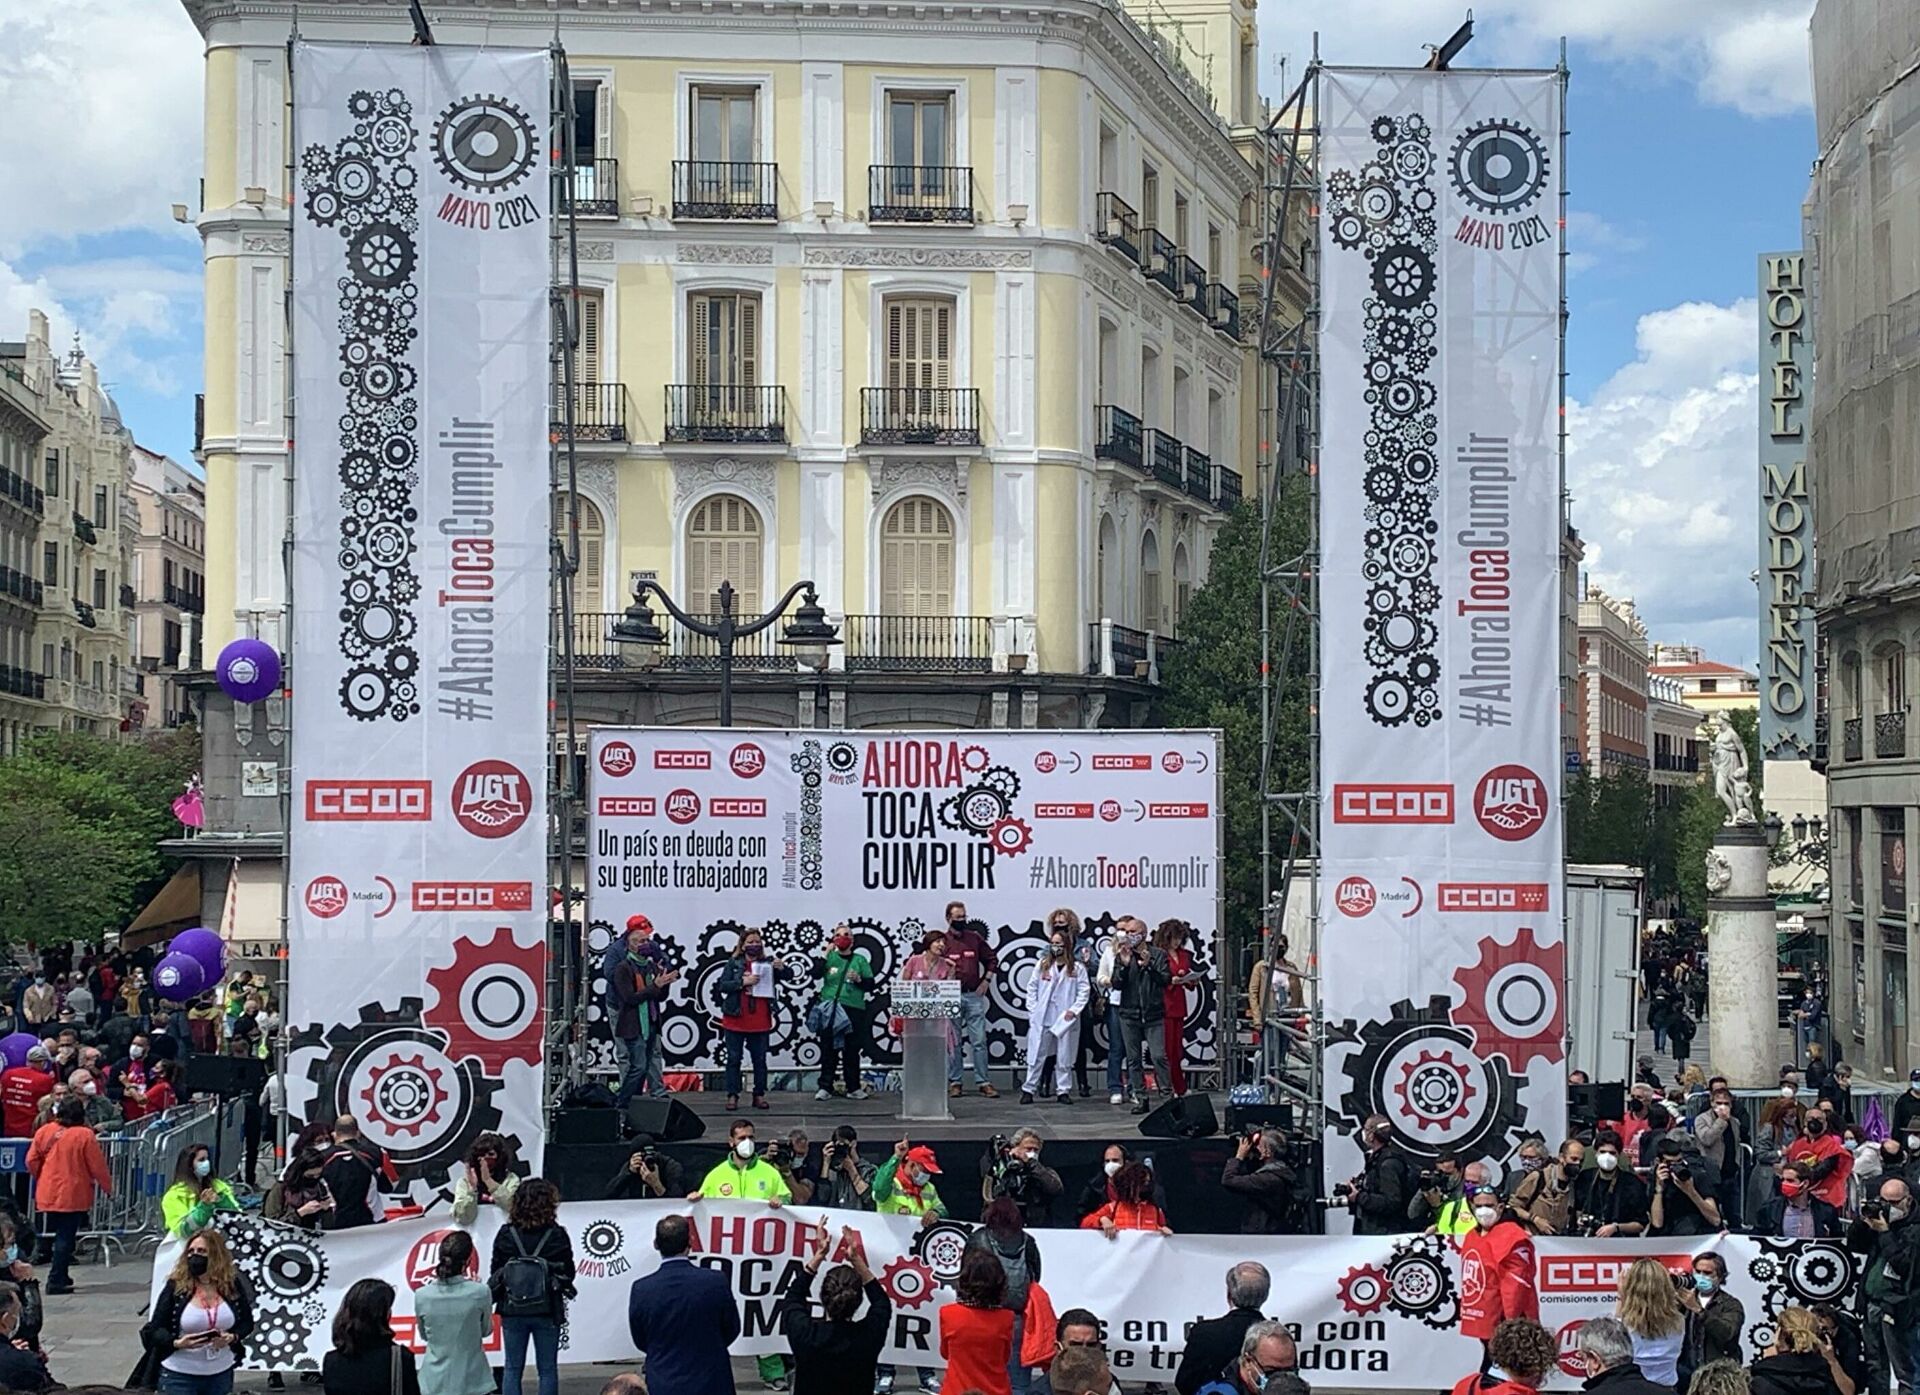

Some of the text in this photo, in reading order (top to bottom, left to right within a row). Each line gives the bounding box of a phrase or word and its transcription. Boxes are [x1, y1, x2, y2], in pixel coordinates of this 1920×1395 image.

[437, 193, 541, 230] MAYO 2021
[1454, 214, 1551, 251] MAYO 2021
[1762, 257, 1808, 714] HOTEL MODERNO
[438, 417, 503, 721] #AhoraTocaCumplir
[1457, 432, 1517, 726] #AhoraTocaCumplir
[606, 747, 630, 762] UGT
[657, 754, 708, 767] CCOO
[736, 748, 760, 763] UGT
[862, 741, 964, 788] AHORA
[1095, 757, 1133, 767] CCOO
[462, 774, 521, 802] UGT
[1484, 779, 1538, 807] UGT
[314, 788, 424, 813] CCOO
[602, 801, 653, 813] CCOO
[672, 795, 696, 809] UGT
[713, 802, 764, 815] CCOO
[1037, 806, 1076, 815] CCOO
[1152, 806, 1190, 815] CCOO
[1342, 792, 1448, 816] CCOO
[862, 792, 937, 839] TOCA
[598, 829, 767, 860] Un país en deuda con
[598, 861, 767, 892] su gente trabajadora
[862, 842, 996, 890] CUMPLIR
[1030, 856, 1209, 893] #AhoraTocaCumplir
[309, 883, 383, 901] UGT Madrid
[418, 888, 494, 905] CCOO
[1340, 883, 1410, 901] UGT Madrid
[1444, 889, 1516, 906] CCOO
[242, 944, 262, 957] LA
[575, 1255, 632, 1278] MAYO 2021
[1540, 1294, 1598, 1304] comisiones
[1123, 1320, 1168, 1342] en
[1316, 1319, 1386, 1342] con
